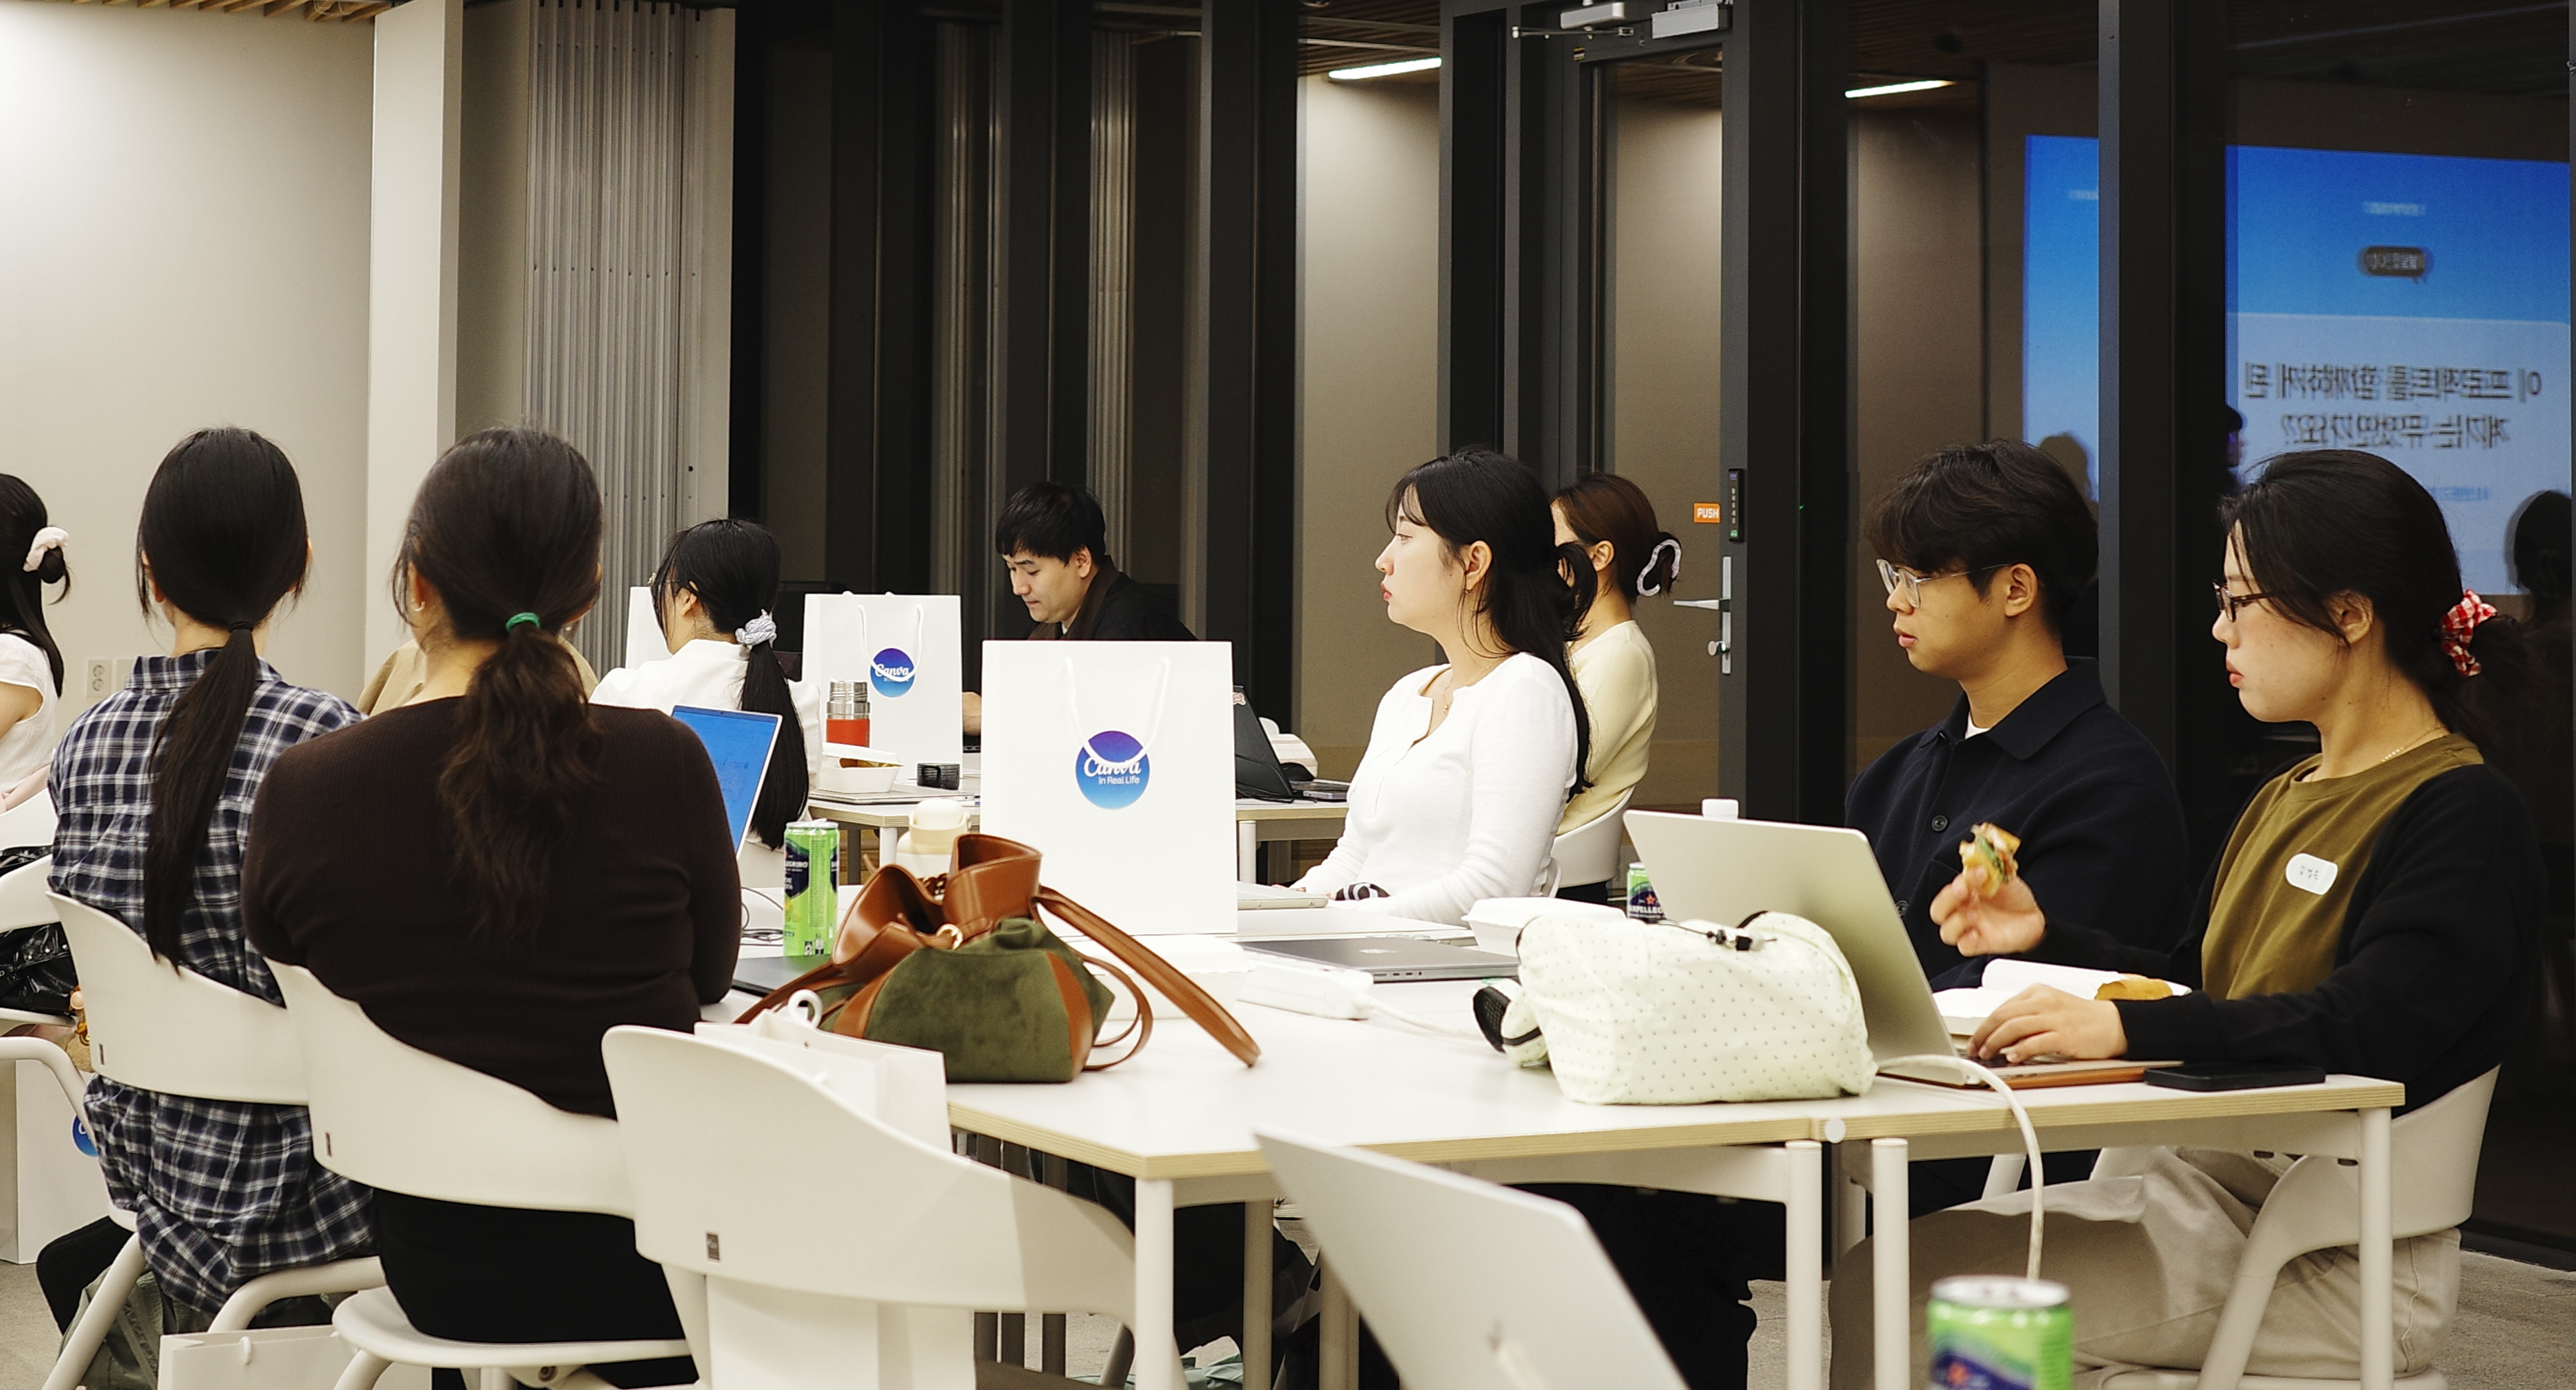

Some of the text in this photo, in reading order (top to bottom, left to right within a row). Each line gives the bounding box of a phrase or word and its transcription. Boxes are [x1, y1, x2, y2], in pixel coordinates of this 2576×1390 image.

[1697, 508, 1719, 519] PUSH
[874, 663, 910, 677] Canva
[1084, 756, 1142, 777] Canva
[1098, 775, 1139, 785] In Real Life
